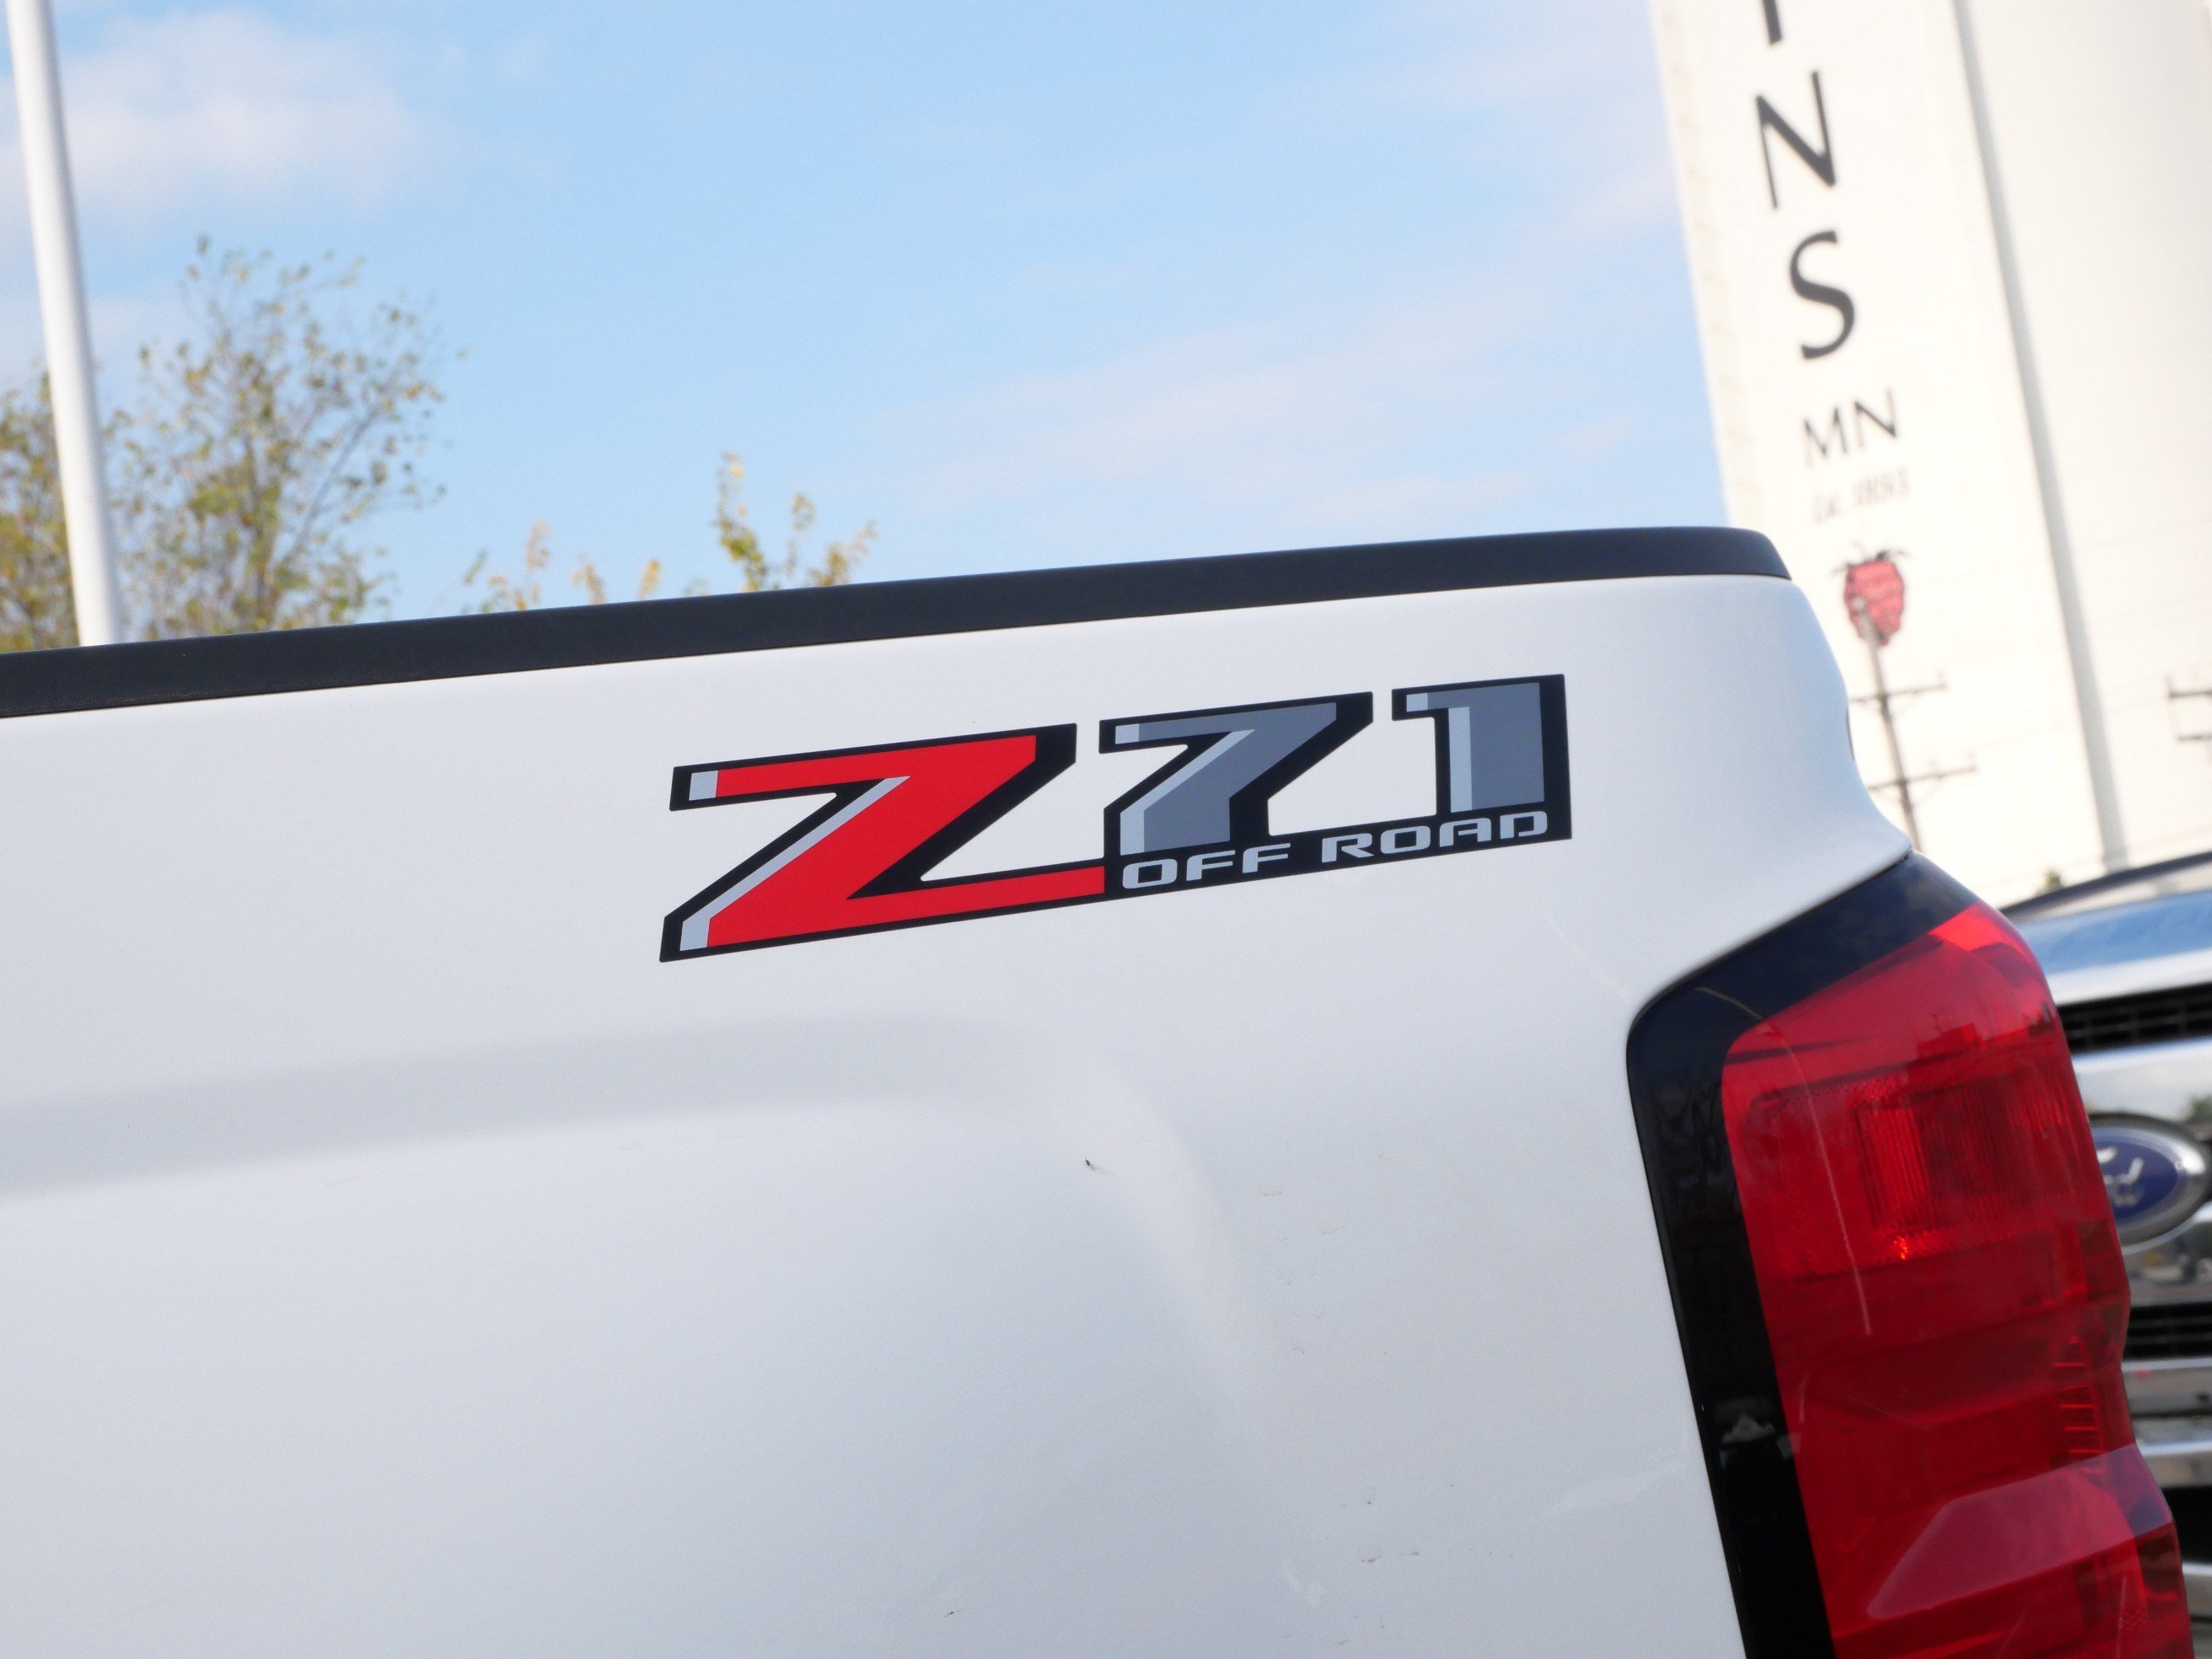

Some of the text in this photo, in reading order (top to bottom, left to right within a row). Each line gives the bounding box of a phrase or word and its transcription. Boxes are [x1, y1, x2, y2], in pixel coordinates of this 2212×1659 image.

[1803, 389, 1898, 464] MN
[660, 674, 1572, 962] Z71
[1122, 810, 1548, 889] OFF ROAD
